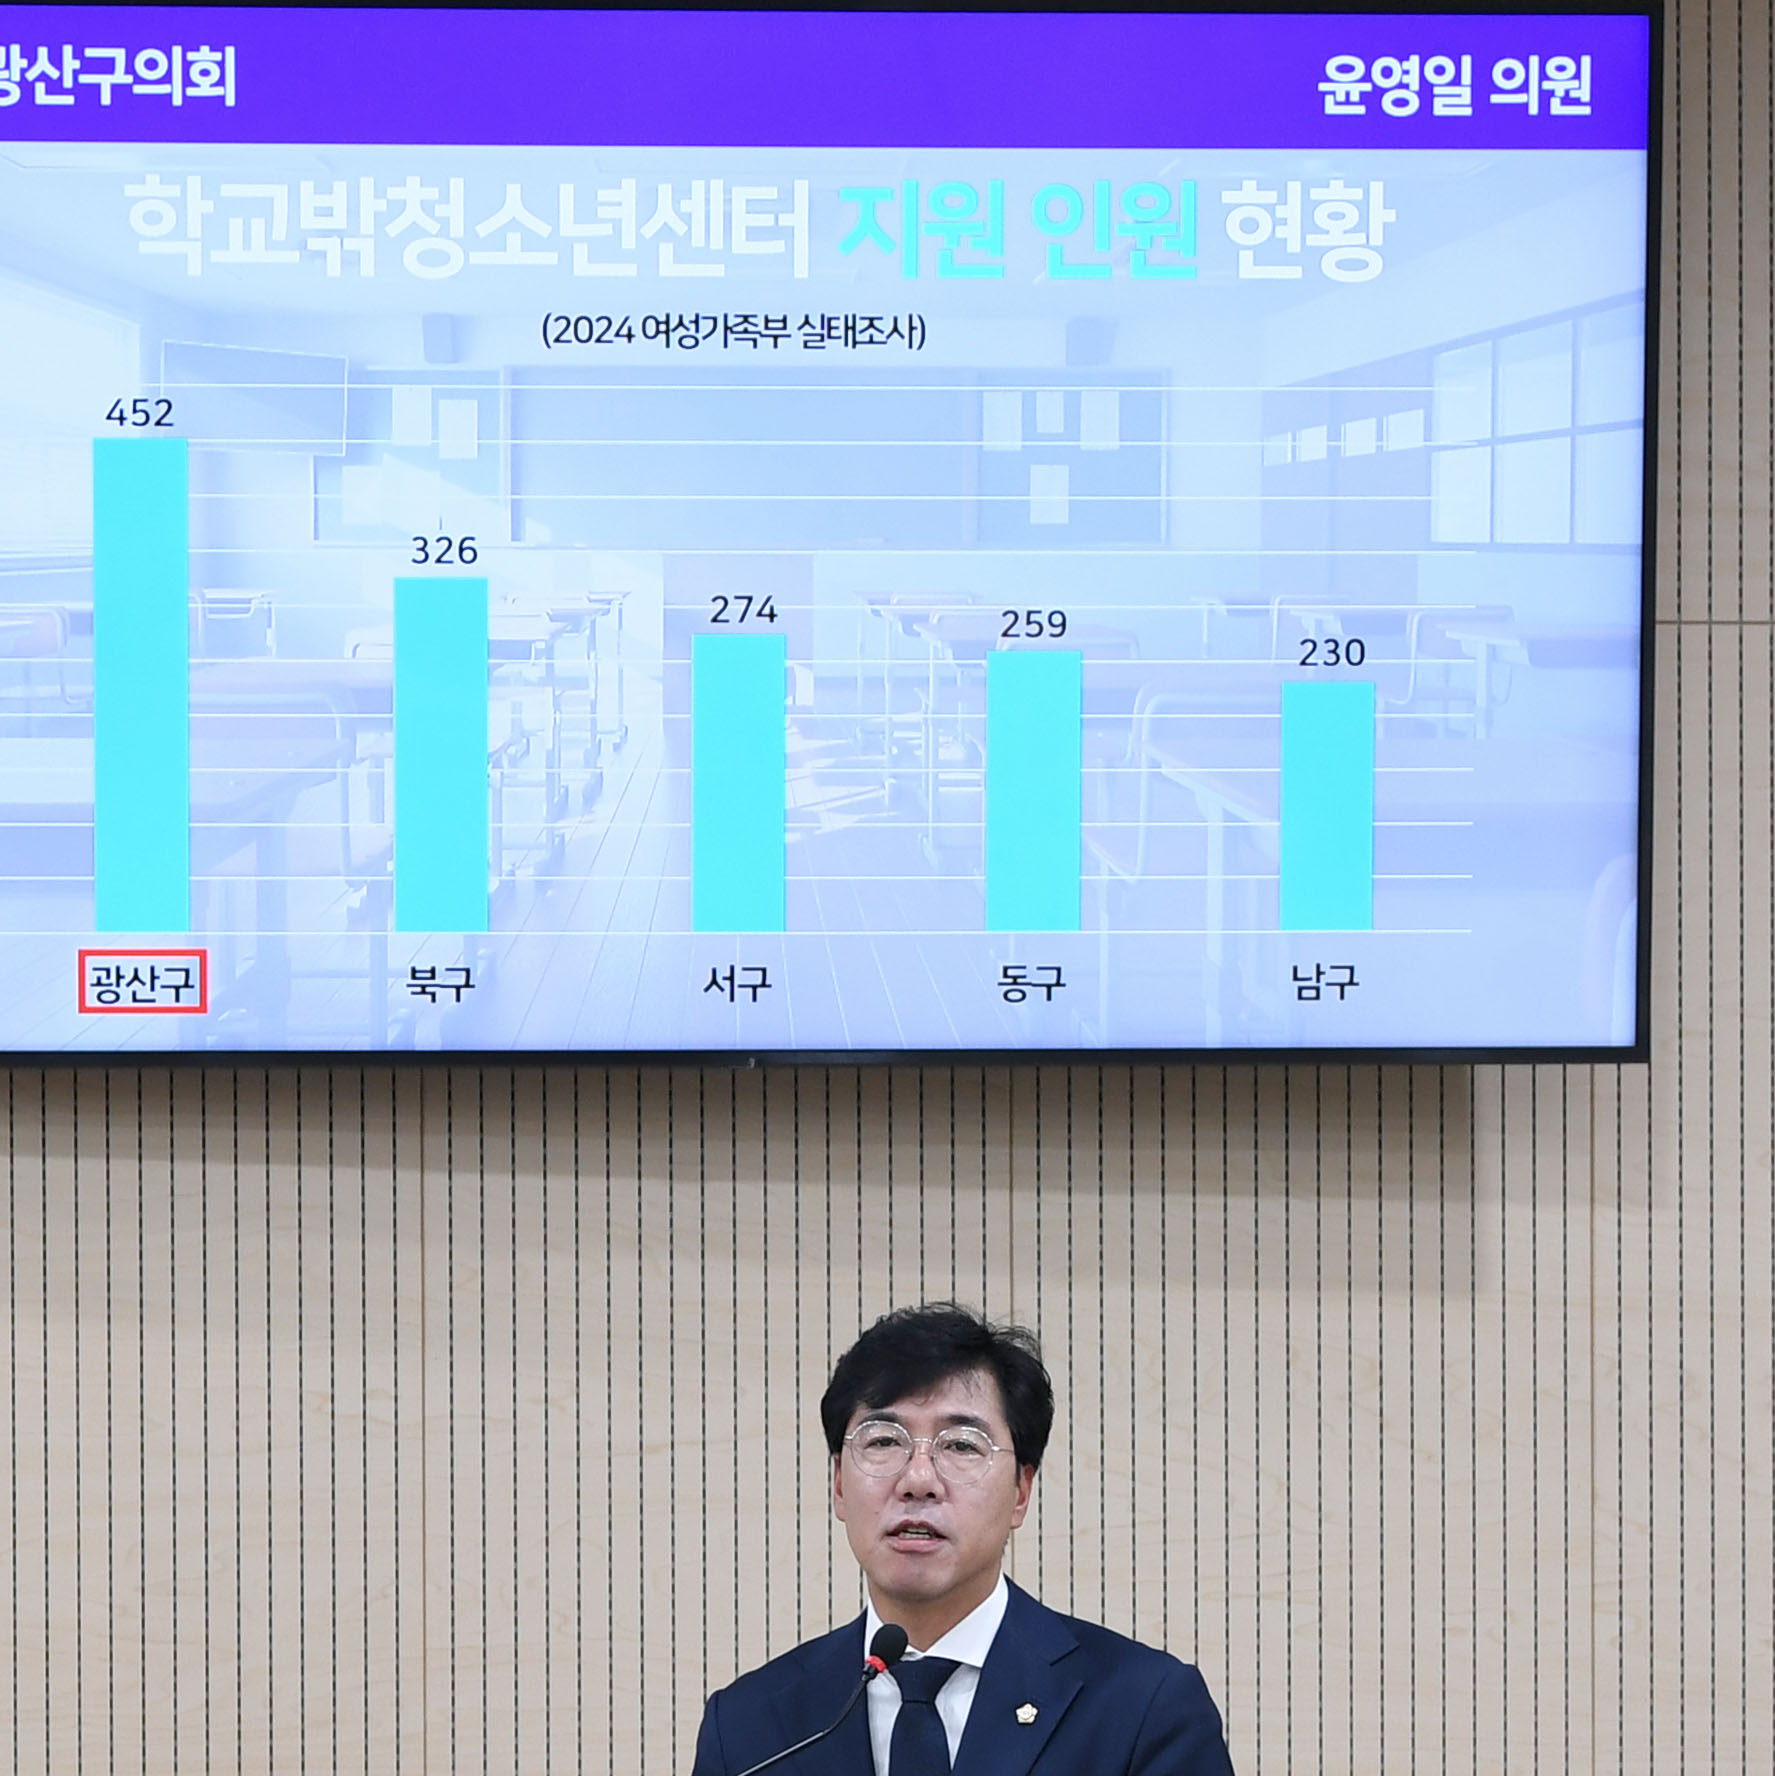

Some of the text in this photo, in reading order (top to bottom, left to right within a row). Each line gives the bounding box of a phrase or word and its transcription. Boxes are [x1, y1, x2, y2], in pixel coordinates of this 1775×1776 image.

[1318, 54, 1592, 117] 윤영일 의원
[124, 174, 1397, 284] 학교밖청소년센터 지원 인원 현황
[541, 313, 927, 351] (2024 여성가족부 실태조사)
[105, 399, 175, 427] 452
[411, 536, 479, 564] 326
[710, 595, 778, 623] 274
[1001, 610, 1068, 638] 259
[1299, 638, 1366, 667] 230
[89, 965, 196, 1004] 광산구
[406, 966, 476, 1003] 북구
[703, 965, 772, 1003] 서구
[997, 965, 1067, 1003] 동구
[1291, 963, 1360, 1001] 남구
